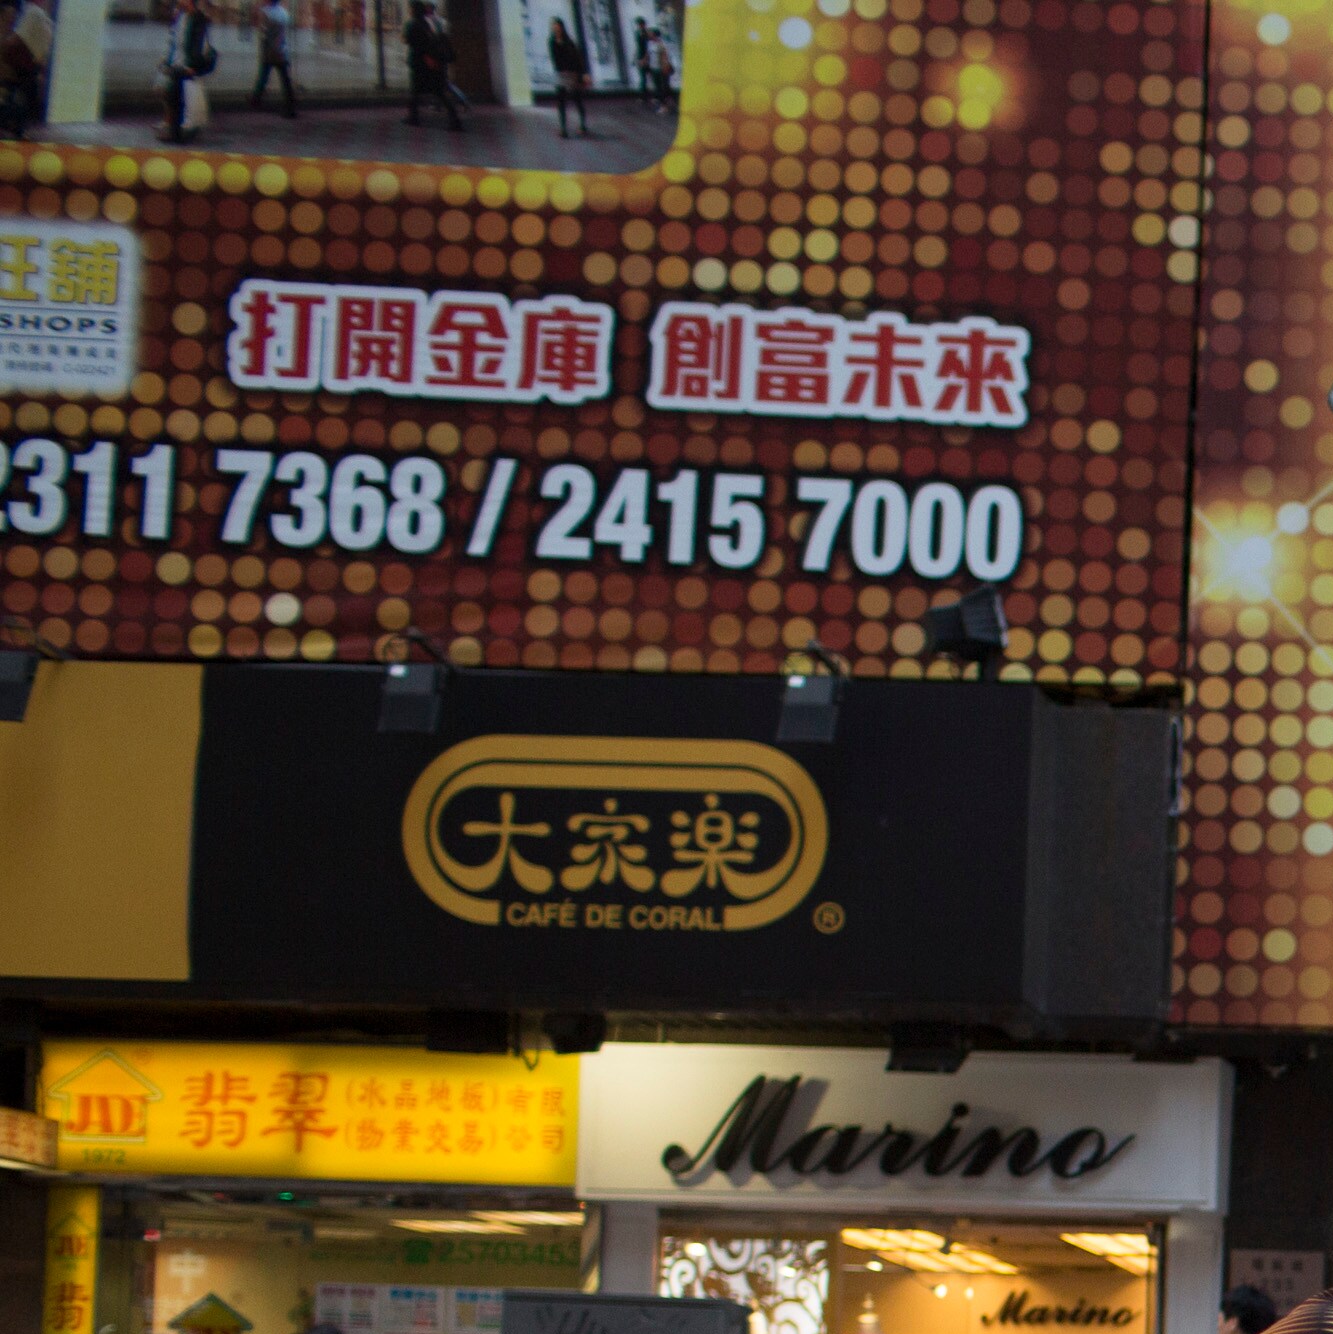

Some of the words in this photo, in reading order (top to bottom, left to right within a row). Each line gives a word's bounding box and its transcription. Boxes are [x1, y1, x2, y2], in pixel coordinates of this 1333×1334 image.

[239, 288, 602, 393] 打開金庫
[660, 312, 1018, 415] 創富未來
[0, 437, 176, 540] 311
[216, 449, 446, 554] 7368
[466, 457, 519, 557] /
[535, 463, 766, 569] 2415
[797, 477, 1024, 582] 7000
[506, 899, 577, 928] CAFÉ
[584, 904, 622, 929] DE
[628, 904, 722, 931] CORAL
[178, 1070, 338, 1153] 翡翠
[661, 1073, 1136, 1180] Marino
[981, 1289, 1142, 1328] Marino
